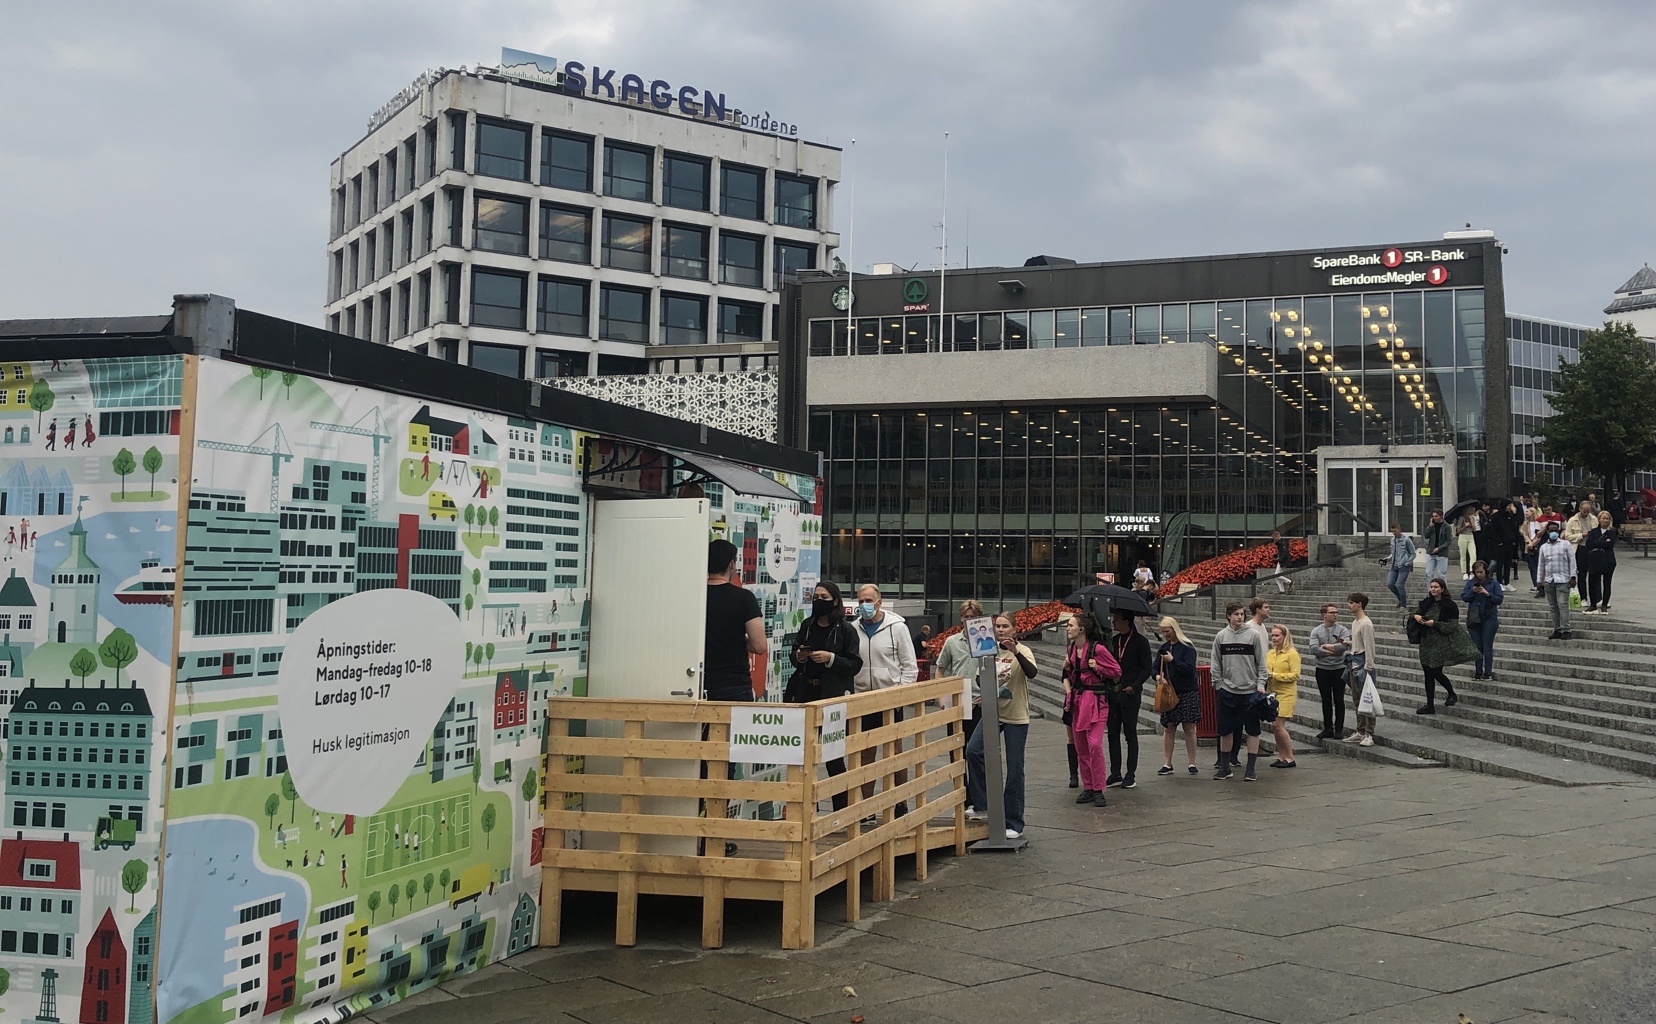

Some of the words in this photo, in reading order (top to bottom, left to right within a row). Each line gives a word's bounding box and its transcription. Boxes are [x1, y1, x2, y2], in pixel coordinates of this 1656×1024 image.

[564, 61, 725, 121] SKAGEN
[1313, 253, 1381, 270] SpareBank
[1404, 249, 1465, 262] SR-Bank
[1331, 270, 1426, 286] EiendomsMegler
[903, 304, 928, 312] SPAR
[1104, 515, 1161, 524] STARBUCKS
[1114, 524, 1150, 532] COFFEE
[316, 637, 396, 661] Åpningstider:
[404, 658, 432, 674] 10-18
[314, 688, 357, 706] Lørdag
[360, 683, 391, 701] 10-17
[752, 713, 784, 725] KUN
[830, 710, 841, 723] KUN
[312, 735, 342, 754] Husk
[345, 727, 410, 751] legitimasjon
[733, 733, 802, 747] INNGANG
[822, 729, 845, 745] INNGANG
